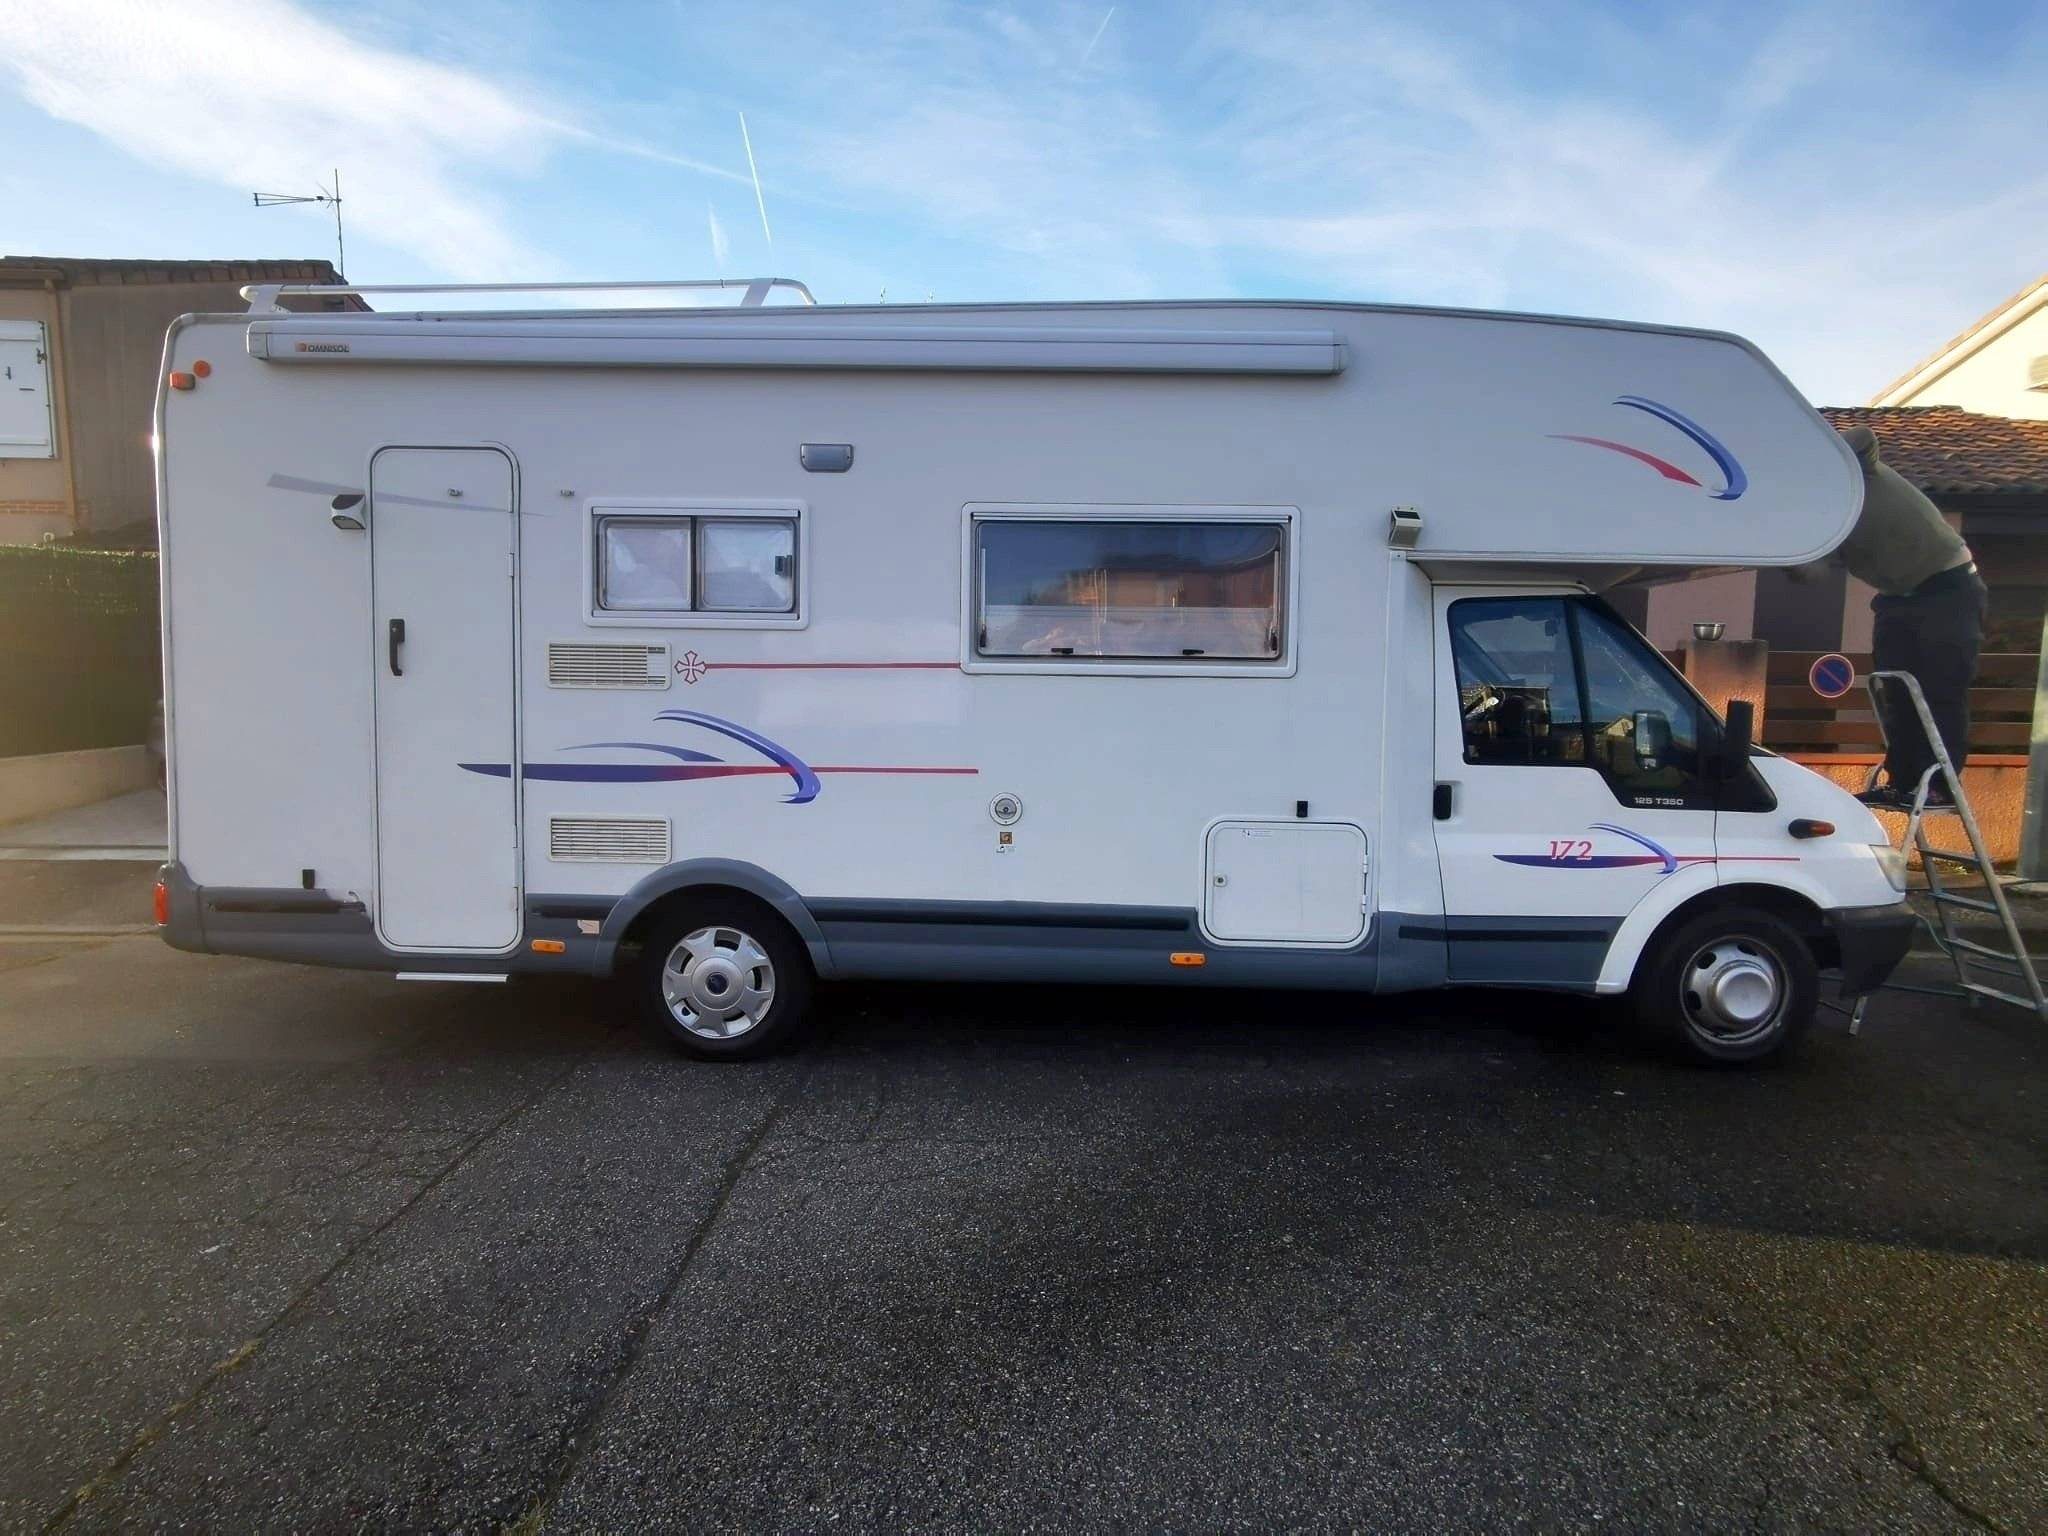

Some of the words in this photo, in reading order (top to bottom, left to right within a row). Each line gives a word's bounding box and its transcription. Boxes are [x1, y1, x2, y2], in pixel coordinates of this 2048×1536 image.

[1634, 796, 1653, 805] 125
[1655, 797, 1684, 806] T350
[1550, 840, 1593, 860] 172
